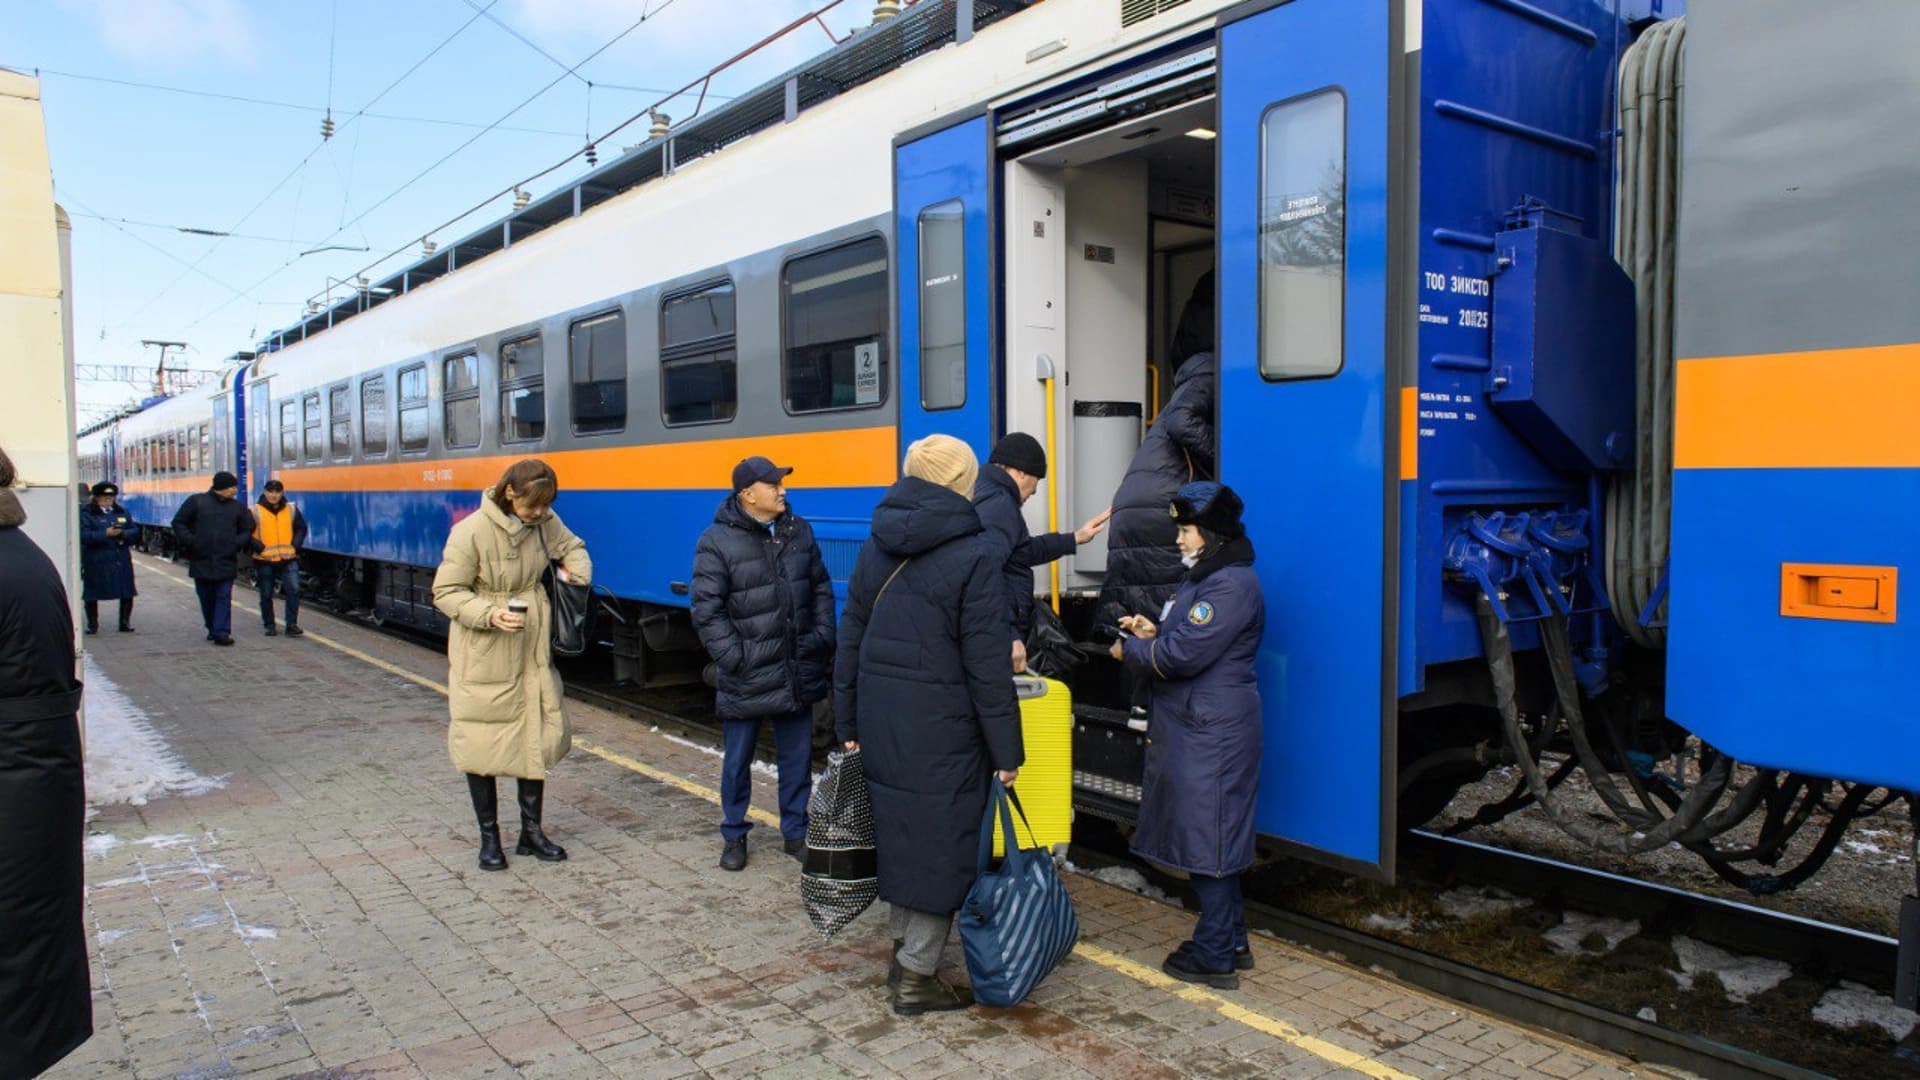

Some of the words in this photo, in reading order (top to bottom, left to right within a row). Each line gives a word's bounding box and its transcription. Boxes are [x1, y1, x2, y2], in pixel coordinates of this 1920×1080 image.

[1425, 272, 1446, 291] ТОО
[1451, 276, 1490, 297] ЗИКСТО
[863, 351, 873, 367] 2
